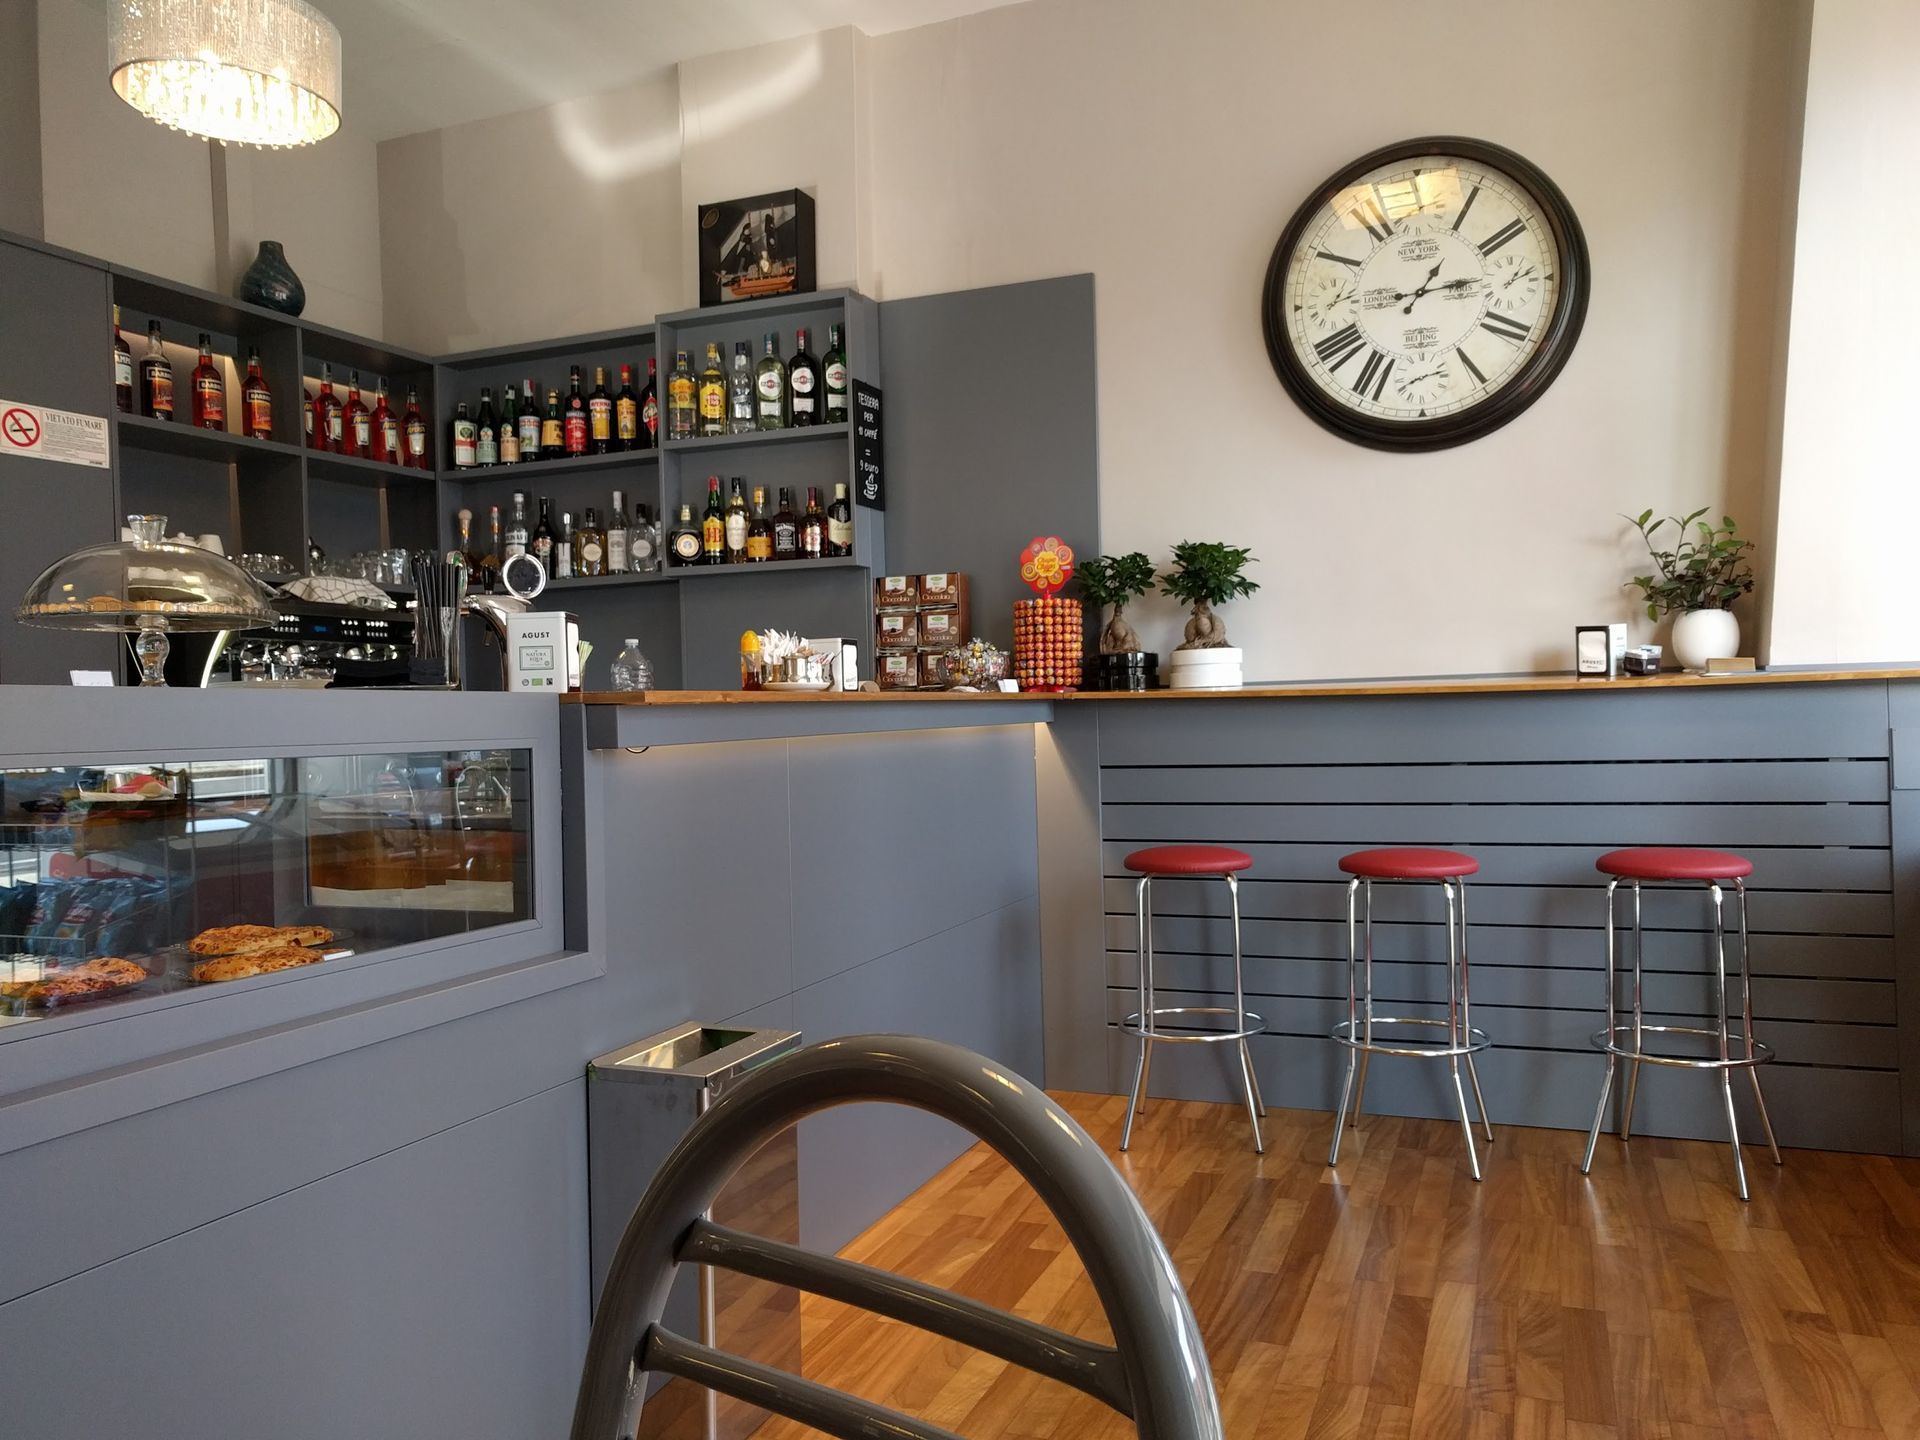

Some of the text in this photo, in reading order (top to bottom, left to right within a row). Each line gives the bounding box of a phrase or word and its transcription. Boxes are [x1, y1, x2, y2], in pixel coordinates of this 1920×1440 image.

[1397, 243, 1441, 257] NEW YORK
[857, 391, 880, 411] TESSERA
[45, 412, 103, 430] VIETATO FUMARE
[864, 462, 879, 475] euro
